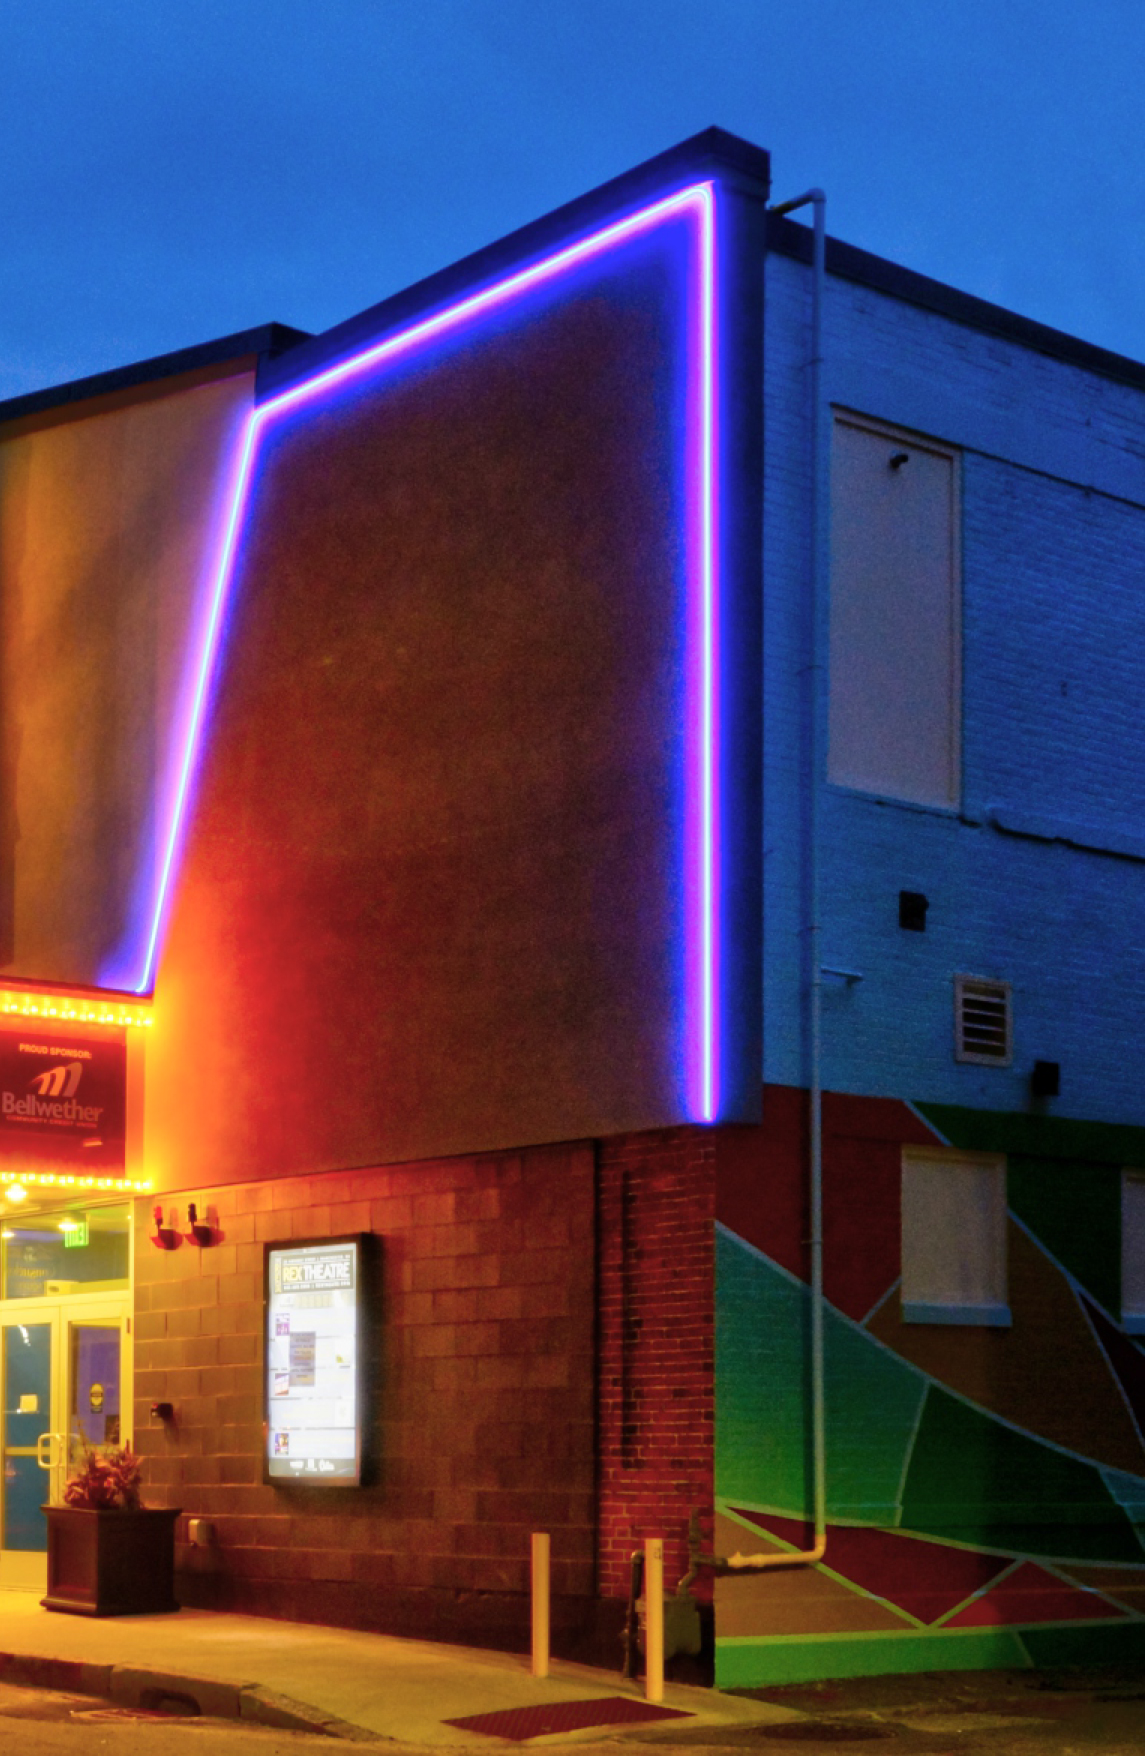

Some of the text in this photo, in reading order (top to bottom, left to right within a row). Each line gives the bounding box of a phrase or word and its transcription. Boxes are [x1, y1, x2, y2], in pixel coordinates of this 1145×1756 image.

[19, 1043, 48, 1054] PROUD
[2, 1091, 103, 1121] Bellwether
[283, 1265, 303, 1283] REX
[303, 1261, 351, 1281] THEATRE
